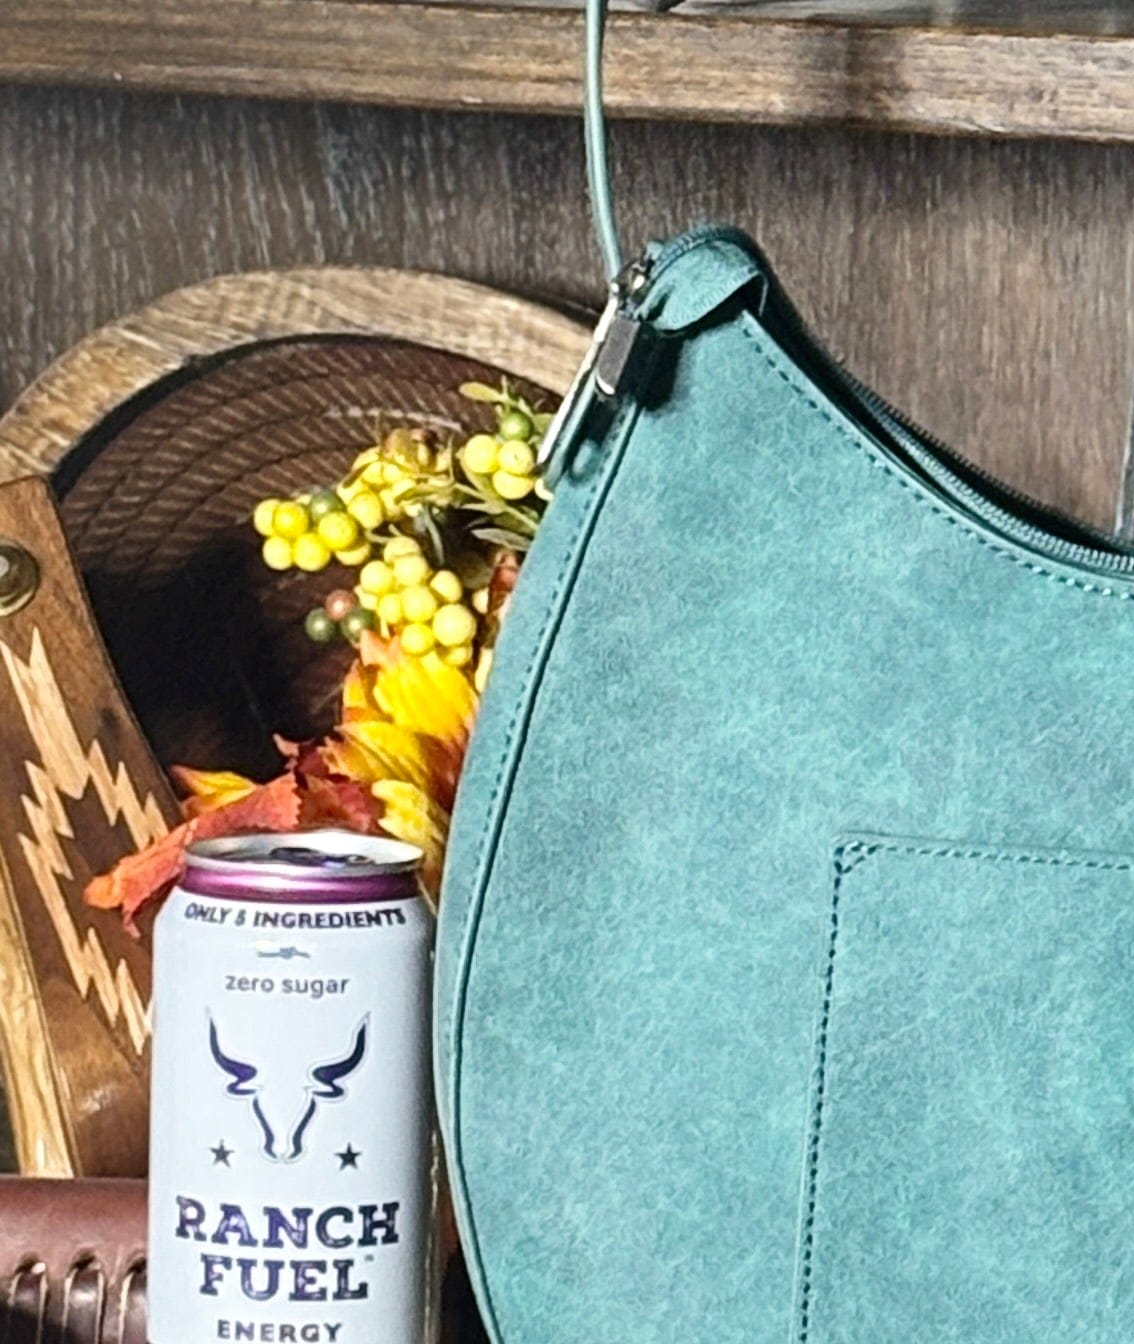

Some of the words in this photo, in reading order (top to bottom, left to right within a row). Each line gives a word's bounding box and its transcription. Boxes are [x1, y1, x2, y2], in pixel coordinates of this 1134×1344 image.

[184, 903, 230, 925] ONLY
[253, 907, 406, 929] INGREDIENTS
[225, 975, 275, 994] zero
[281, 978, 349, 1000] sugar
[176, 1195, 400, 1249] RANCH
[199, 1253, 368, 1302] FUEL
[217, 1319, 342, 1344] ENERGY
